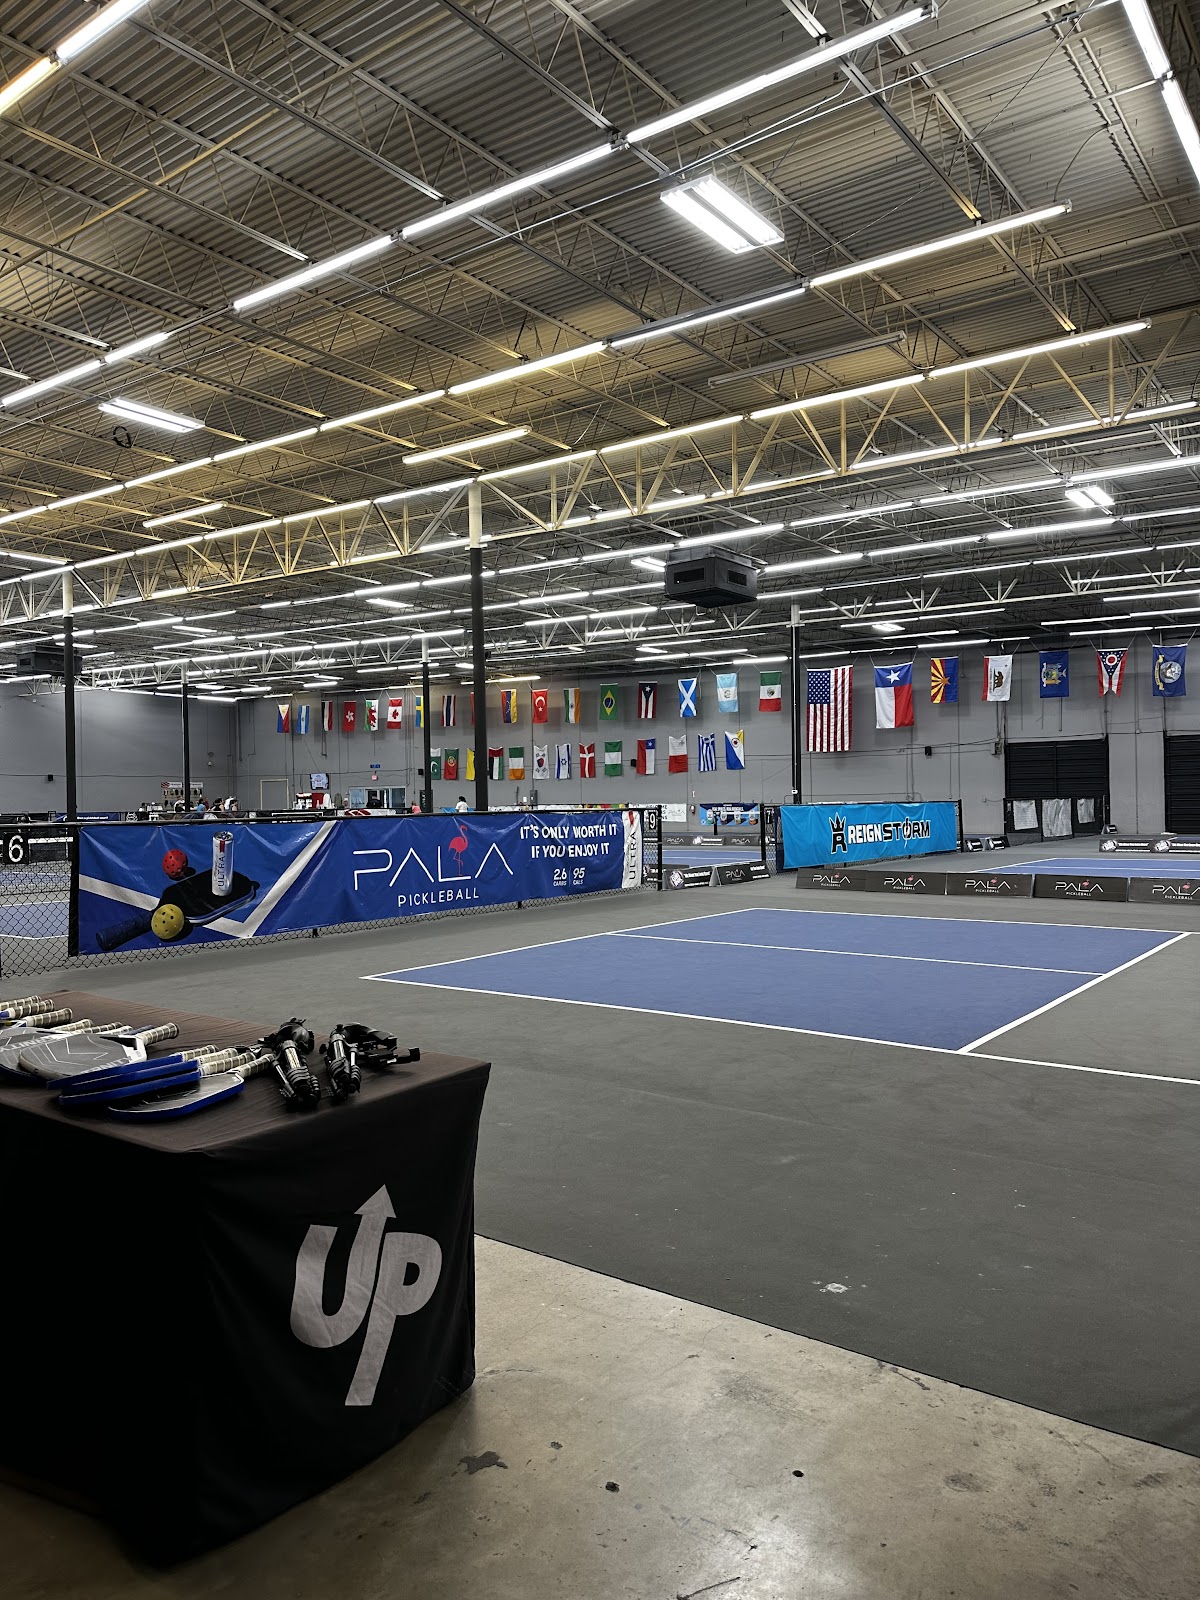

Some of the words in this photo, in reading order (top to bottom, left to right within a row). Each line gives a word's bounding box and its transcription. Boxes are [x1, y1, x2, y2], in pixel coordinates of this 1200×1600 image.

[649, 813, 656, 829] 9
[520, 823, 540, 840] IT'S
[541, 826, 570, 839] ONLY
[572, 824, 607, 839] WORTH
[608, 823, 618, 836] IT
[8, 834, 24, 863] 6
[531, 845, 540, 859] IF
[542, 845, 566, 858] YOU
[568, 843, 599, 858] ENJOY
[600, 842, 610, 855] IT
[629, 831, 637, 880] ULTRA
[217, 855, 226, 887] ULTRA
[352, 842, 514, 891] PALA
[553, 868, 568, 880] 2.6
[572, 867, 586, 879] 95
[812, 874, 851, 884] PALA
[883, 877, 926, 887] PALA
[964, 880, 1011, 890] PALA
[1054, 881, 1104, 893] PALA
[397, 887, 480, 908] PICKLEBALL
[290, 1184, 442, 1406] UP
